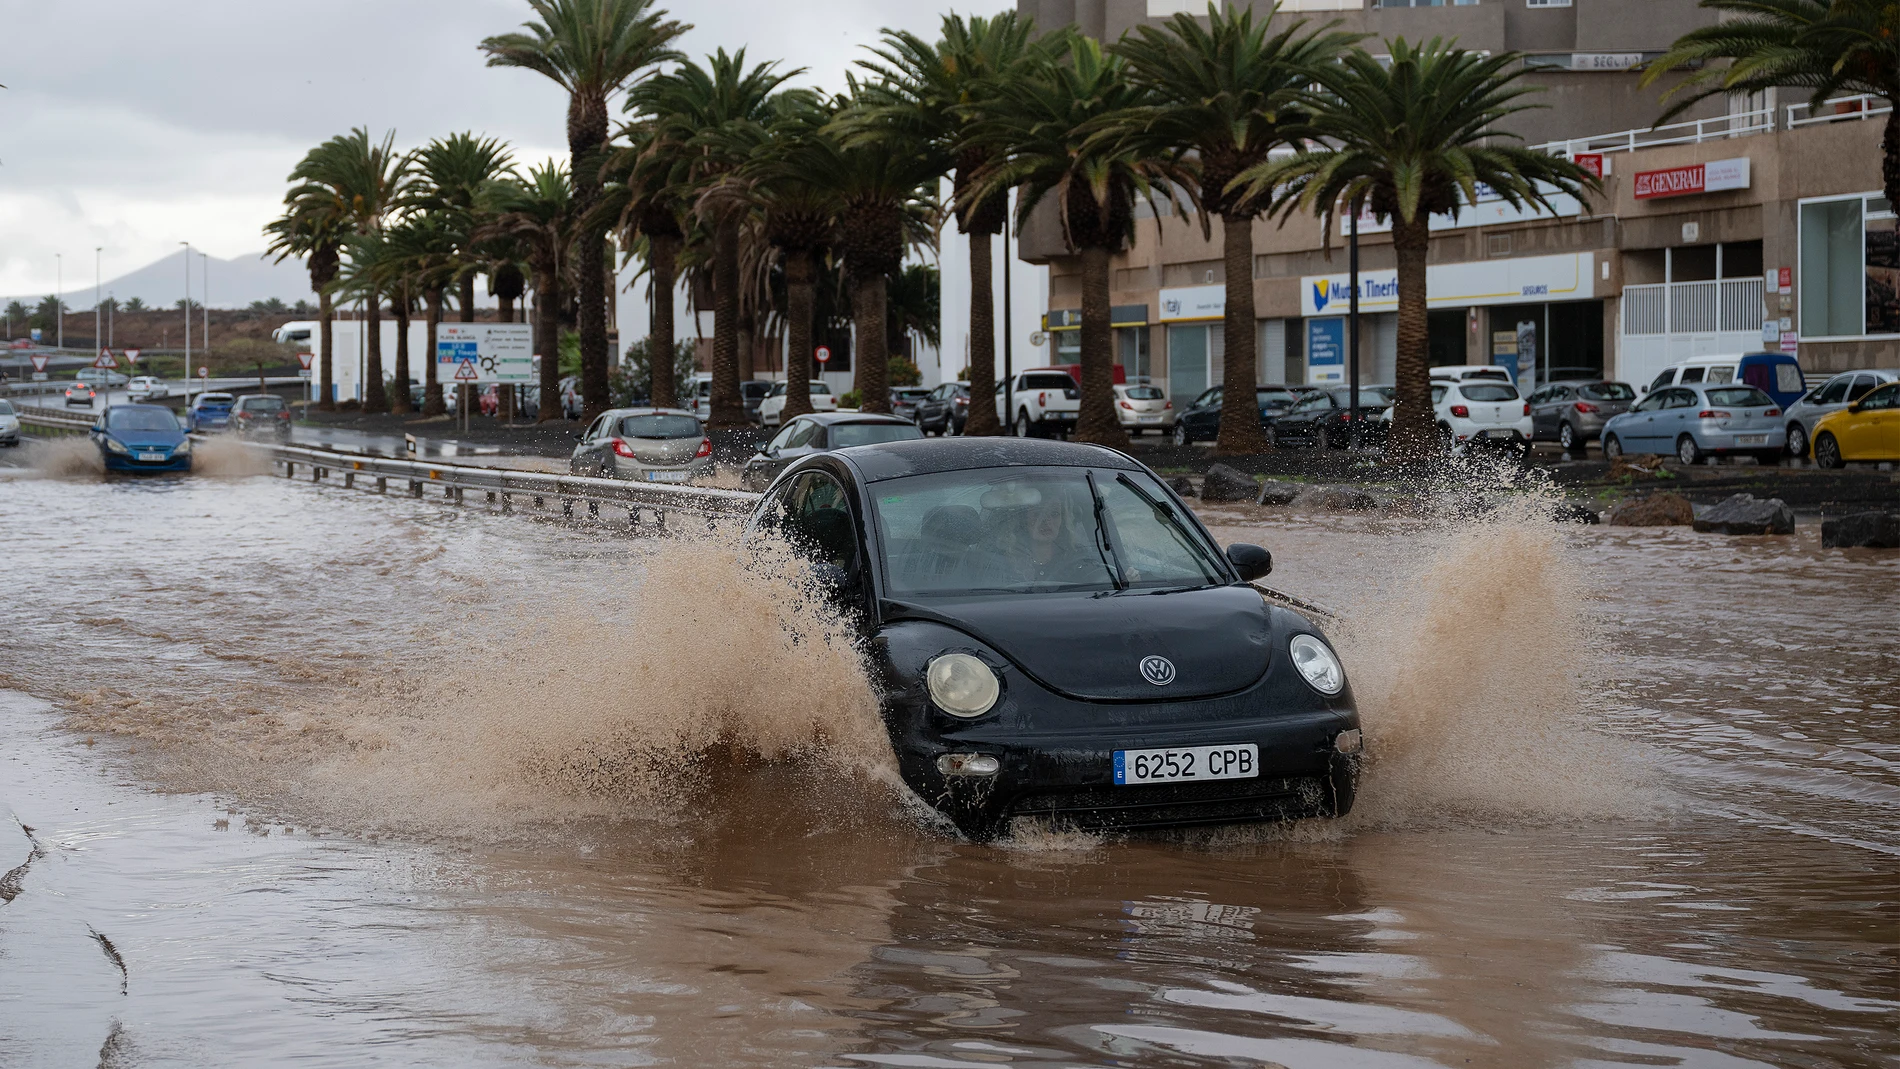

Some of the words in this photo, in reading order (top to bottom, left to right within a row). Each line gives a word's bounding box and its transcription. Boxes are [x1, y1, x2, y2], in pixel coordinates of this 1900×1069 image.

[1651, 168, 1703, 193] GENERALI
[1117, 771, 1123, 779] E
[1135, 752, 1196, 779] 6252
[1208, 749, 1252, 775] CPB
